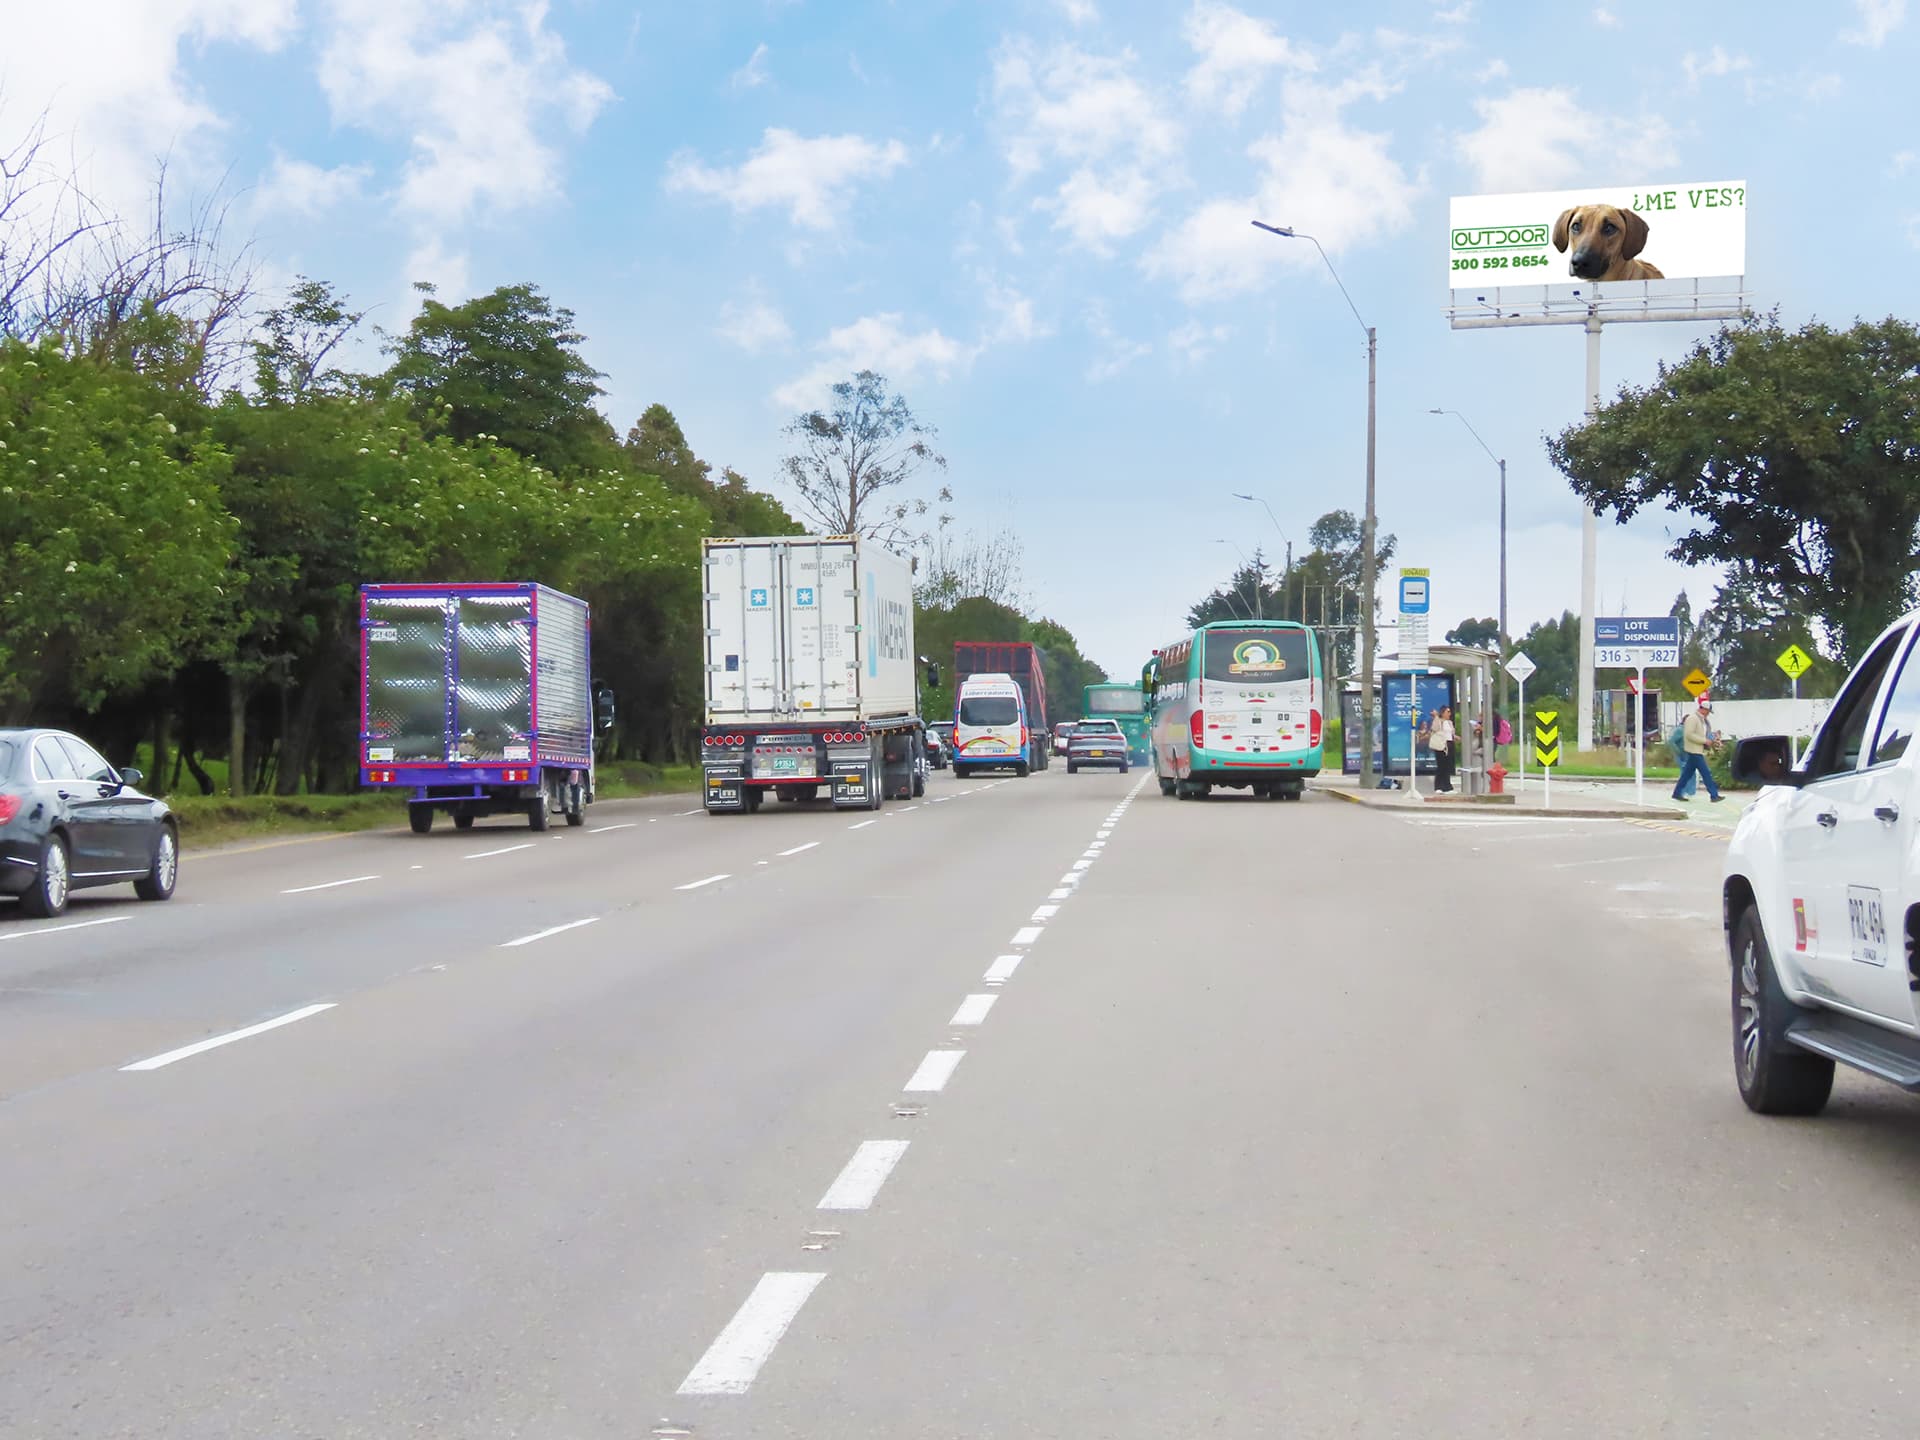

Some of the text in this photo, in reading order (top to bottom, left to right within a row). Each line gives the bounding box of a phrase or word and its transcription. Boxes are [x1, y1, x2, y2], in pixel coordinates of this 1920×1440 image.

[1632, 187, 1745, 211] ¿ME VES?
[1455, 228, 1546, 246] OUTDOOR
[1451, 254, 1549, 271] 300 592 8654
[1623, 621, 1649, 631] LOTE
[1623, 633, 1675, 642] DISPONIBLE
[1600, 649, 1622, 662] 316
